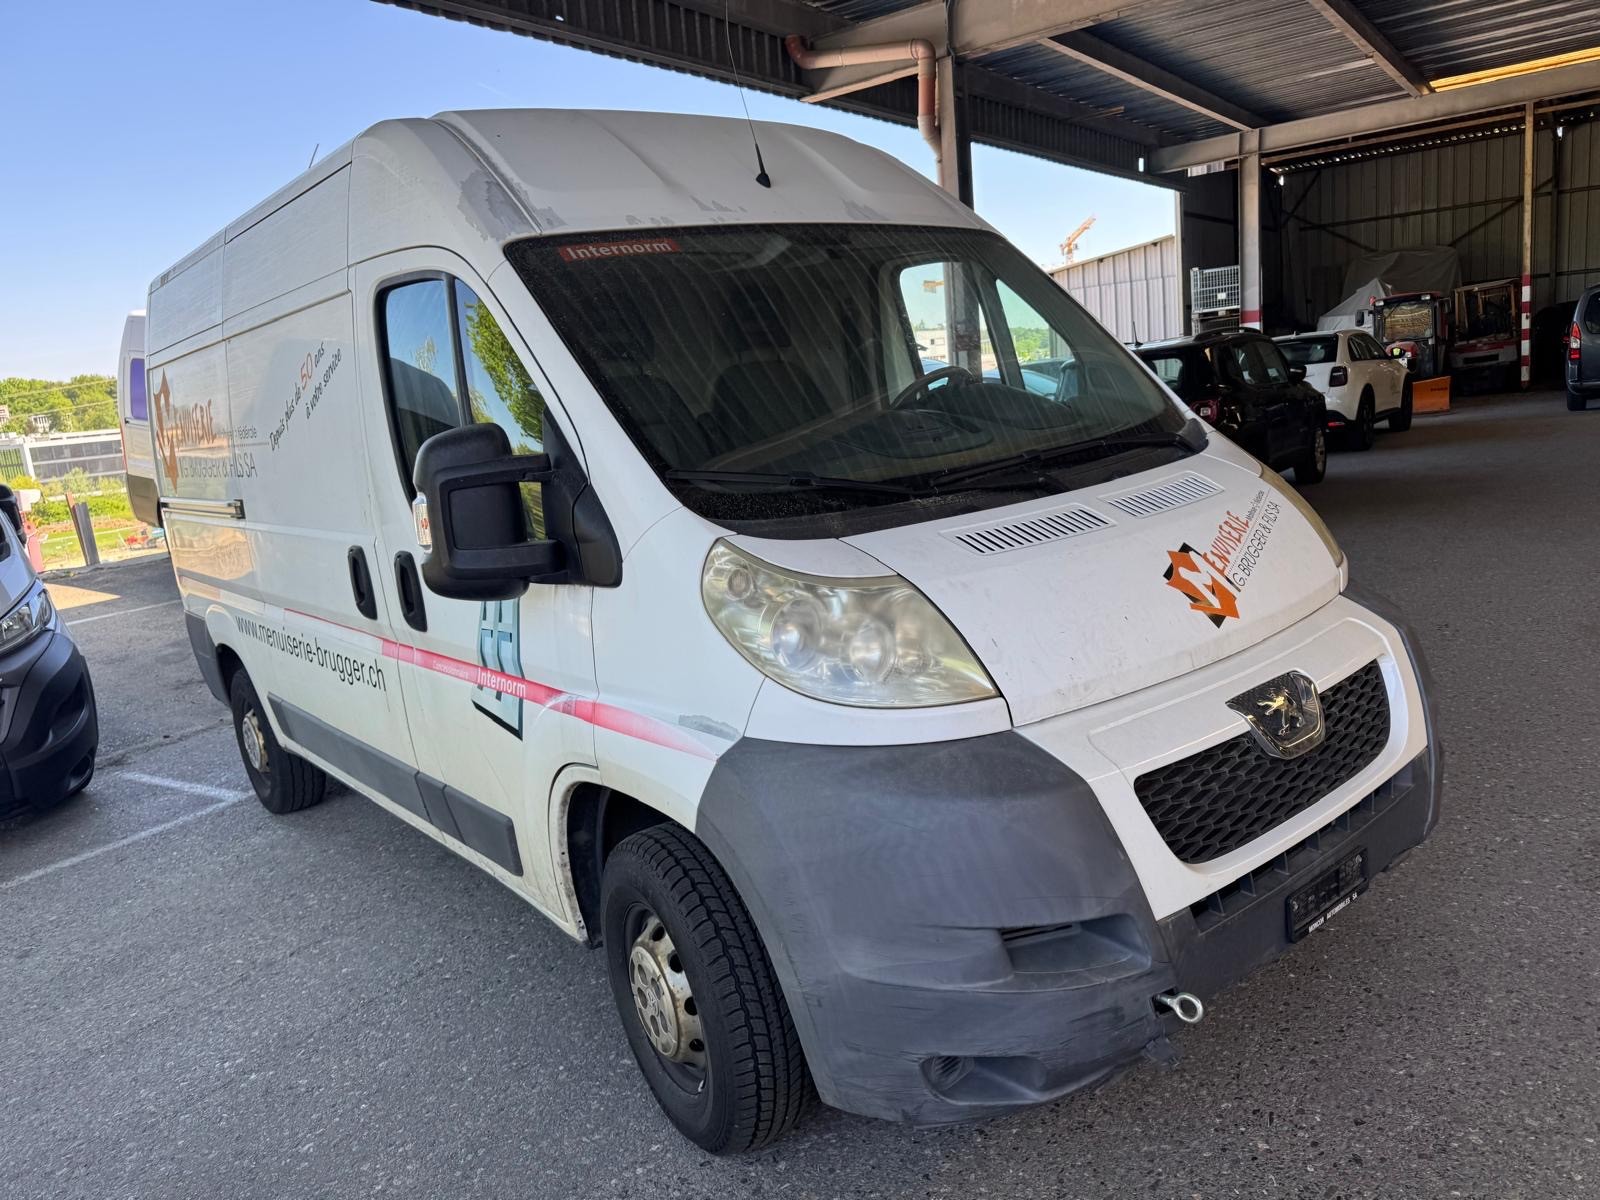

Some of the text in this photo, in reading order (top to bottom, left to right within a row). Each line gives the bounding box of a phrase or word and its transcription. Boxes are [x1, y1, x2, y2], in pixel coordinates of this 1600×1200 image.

[566, 242, 672, 260] Internorm
[269, 341, 325, 451] Depuis plus de 50 ans
[310, 383, 323, 411] votre
[323, 348, 342, 388] service
[1259, 522, 1273, 534] &
[1238, 529, 1268, 577] BRUGGER
[1232, 572, 1247, 587] G.
[235, 615, 387, 692] www.menuiserie-brugger.ch
[477, 667, 527, 698] Internorm
